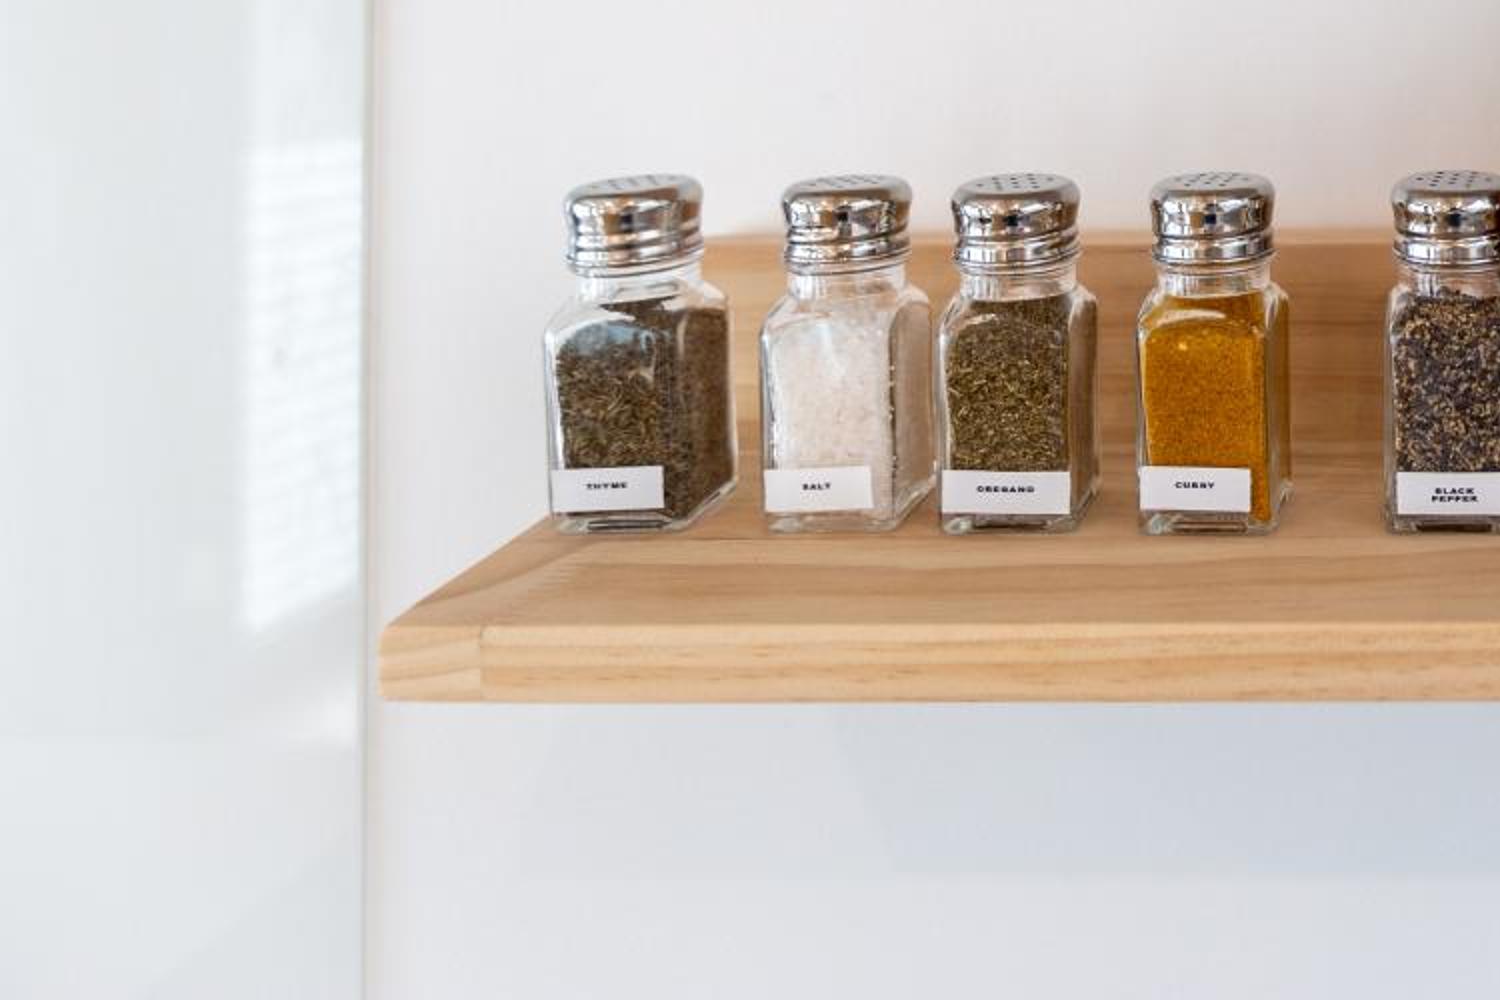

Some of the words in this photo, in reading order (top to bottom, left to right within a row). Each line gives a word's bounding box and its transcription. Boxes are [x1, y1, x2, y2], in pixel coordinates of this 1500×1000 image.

[586, 482, 628, 490] THYME
[976, 485, 1035, 493] OREGANO
[1175, 481, 1215, 489] CURRY
